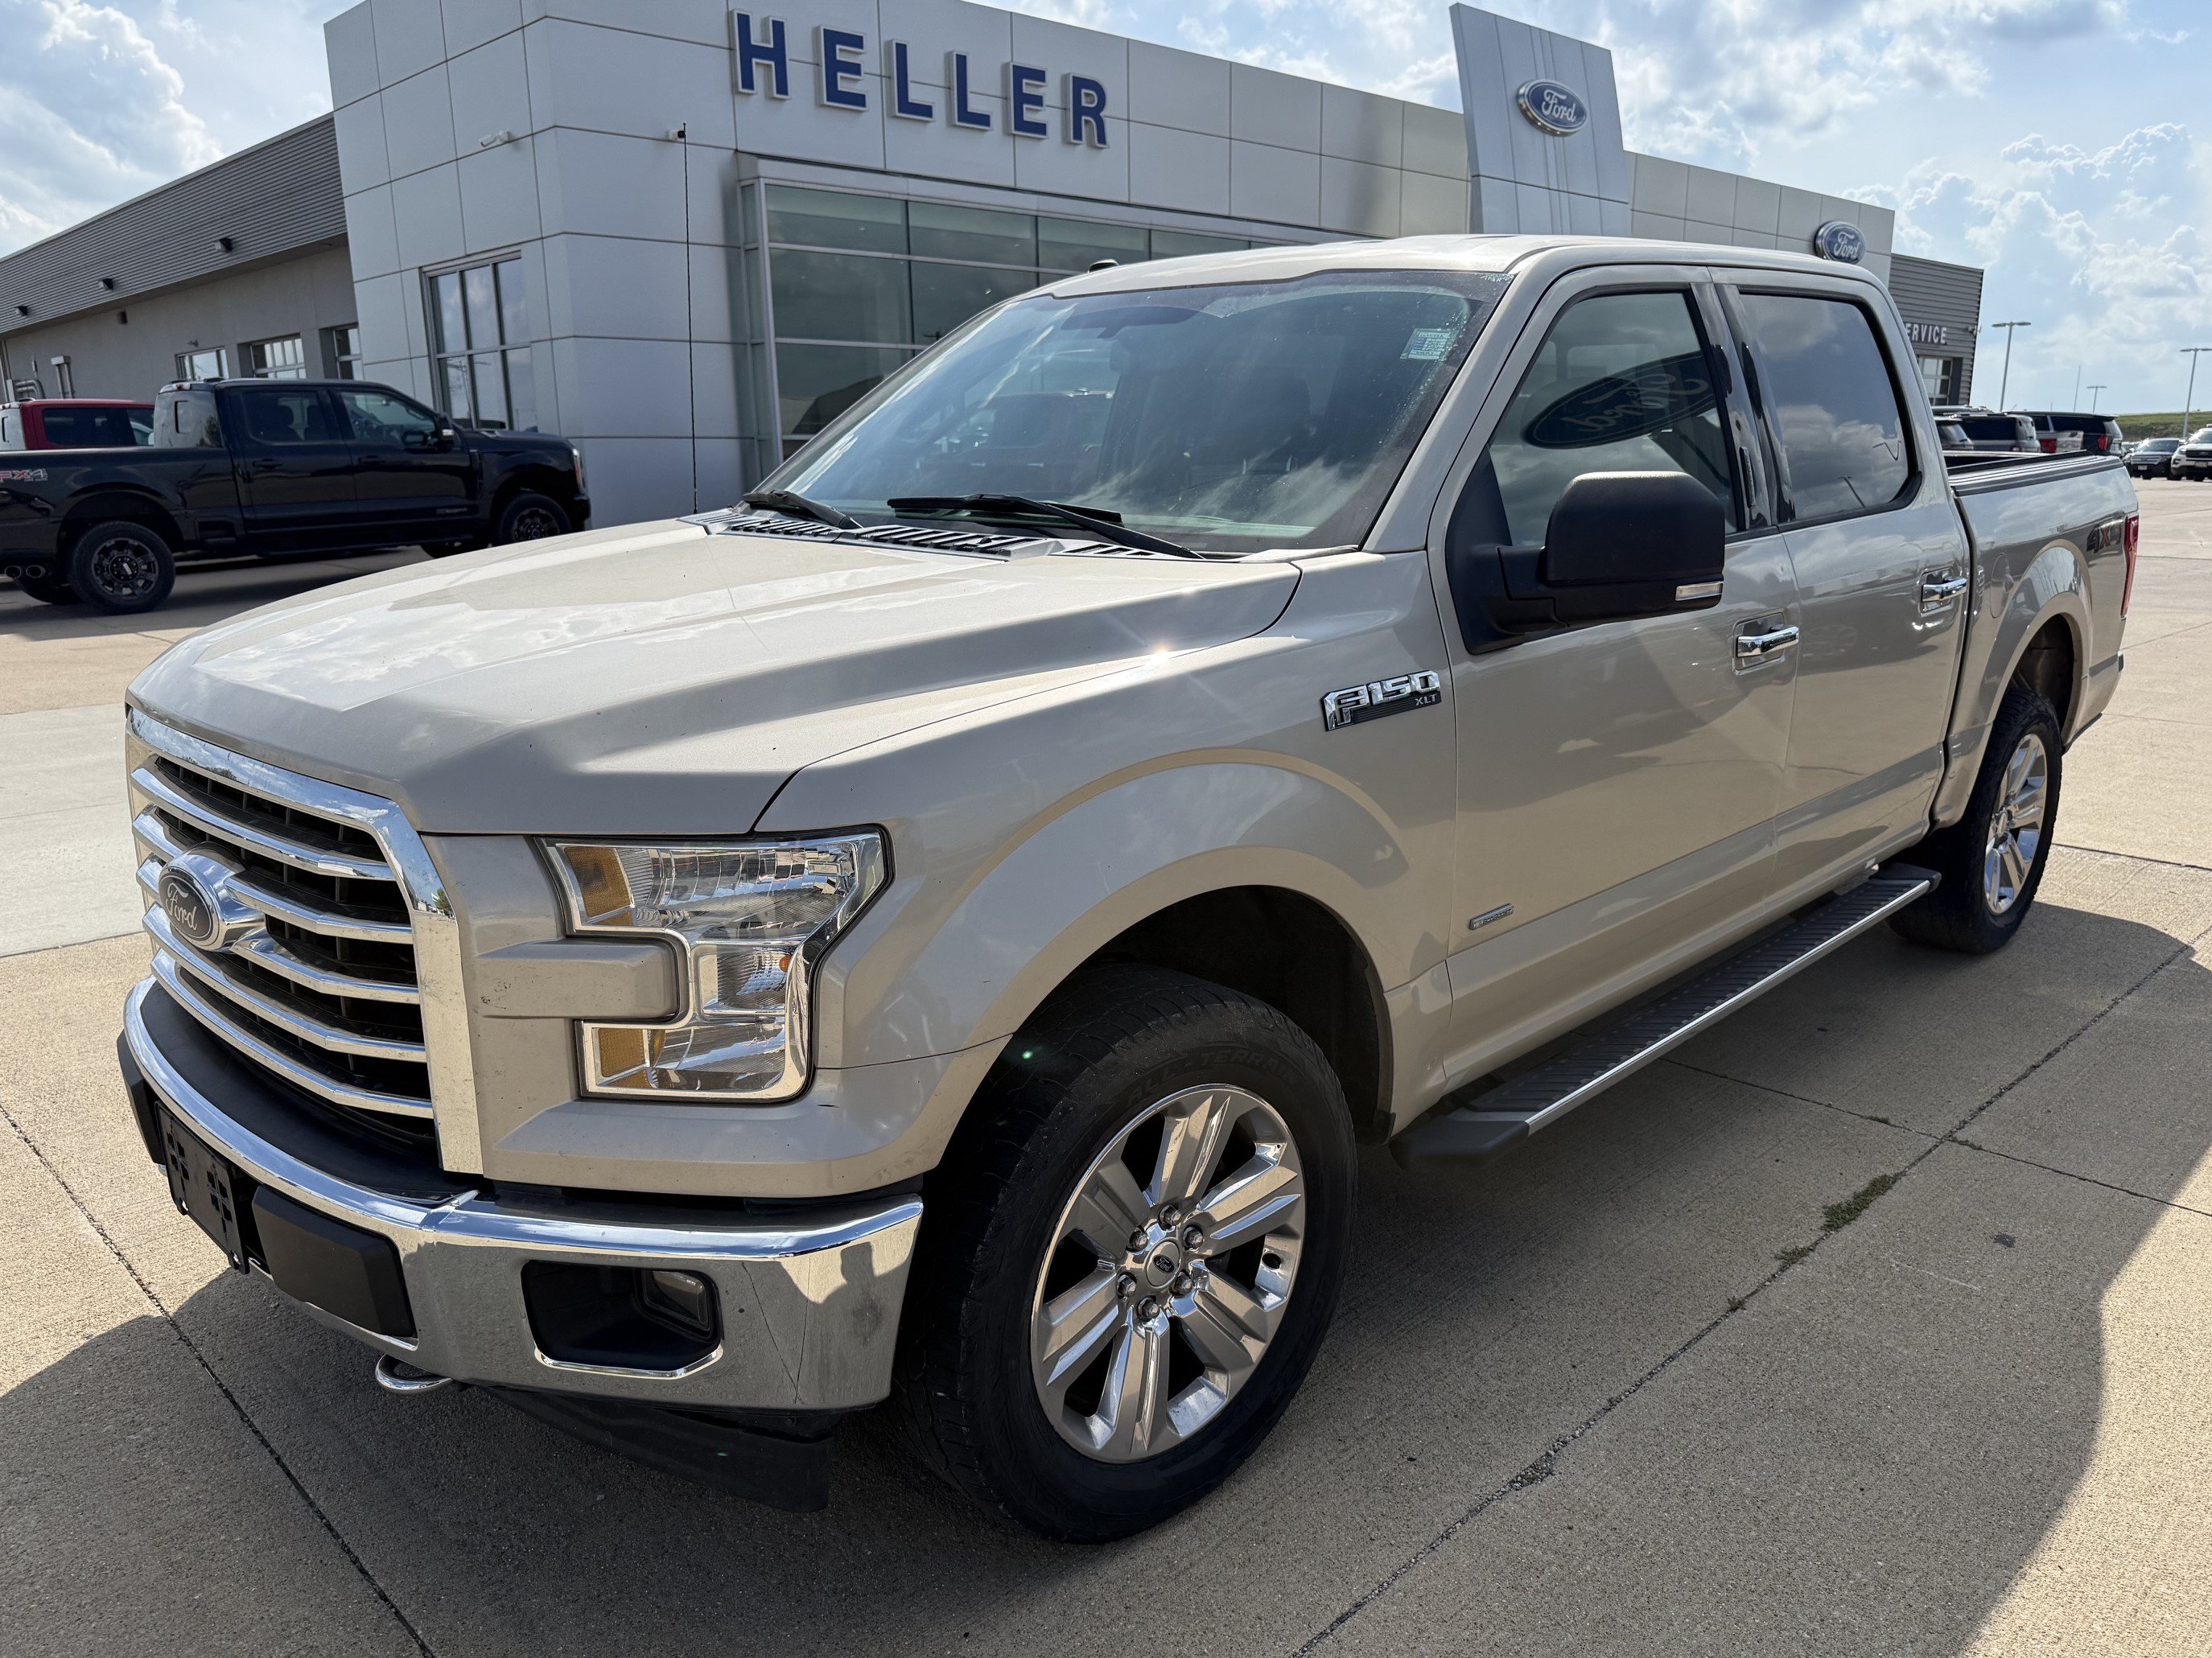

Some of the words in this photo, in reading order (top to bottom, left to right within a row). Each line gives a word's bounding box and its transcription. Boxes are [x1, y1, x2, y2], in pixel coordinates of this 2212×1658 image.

[730, 10, 1108, 148] HELLER
[1541, 89, 1577, 122] Ford
[1834, 231, 1860, 259] Ford
[1905, 323, 1946, 344] ERVICE
[1324, 670, 1441, 731] F150
[1415, 693, 1437, 706] XLT
[166, 882, 197, 931] Ford
[1155, 1257, 1172, 1272] Ford
